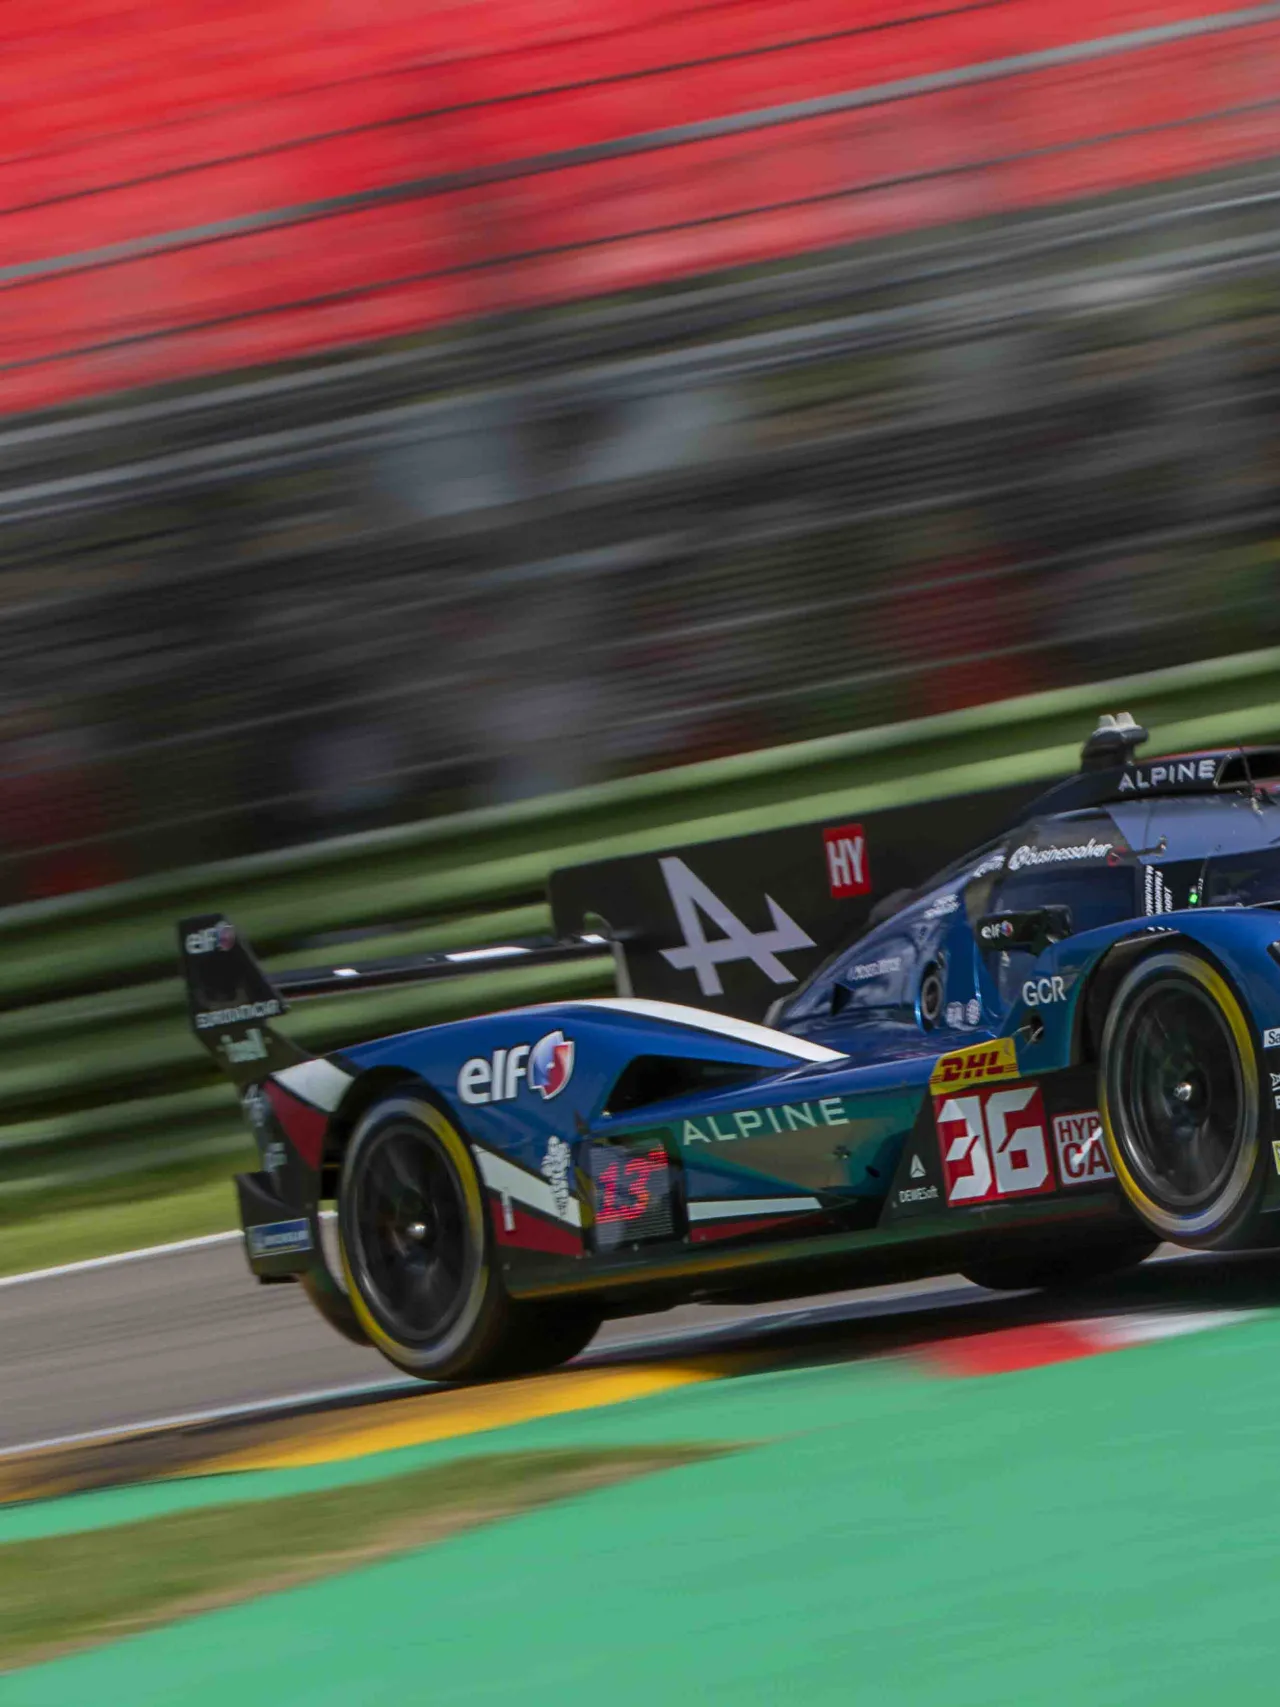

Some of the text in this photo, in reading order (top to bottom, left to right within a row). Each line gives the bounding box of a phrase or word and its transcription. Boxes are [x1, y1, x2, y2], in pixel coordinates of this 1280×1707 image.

[1117, 759, 1216, 791] ALPINE
[826, 835, 864, 887] HY
[981, 922, 1001, 940] elf
[1021, 975, 1067, 1007] GCR
[457, 1044, 530, 1104] elf
[939, 1050, 1005, 1081] DHL
[681, 1097, 850, 1146] ALPINE
[937, 1086, 1049, 1200] 36
